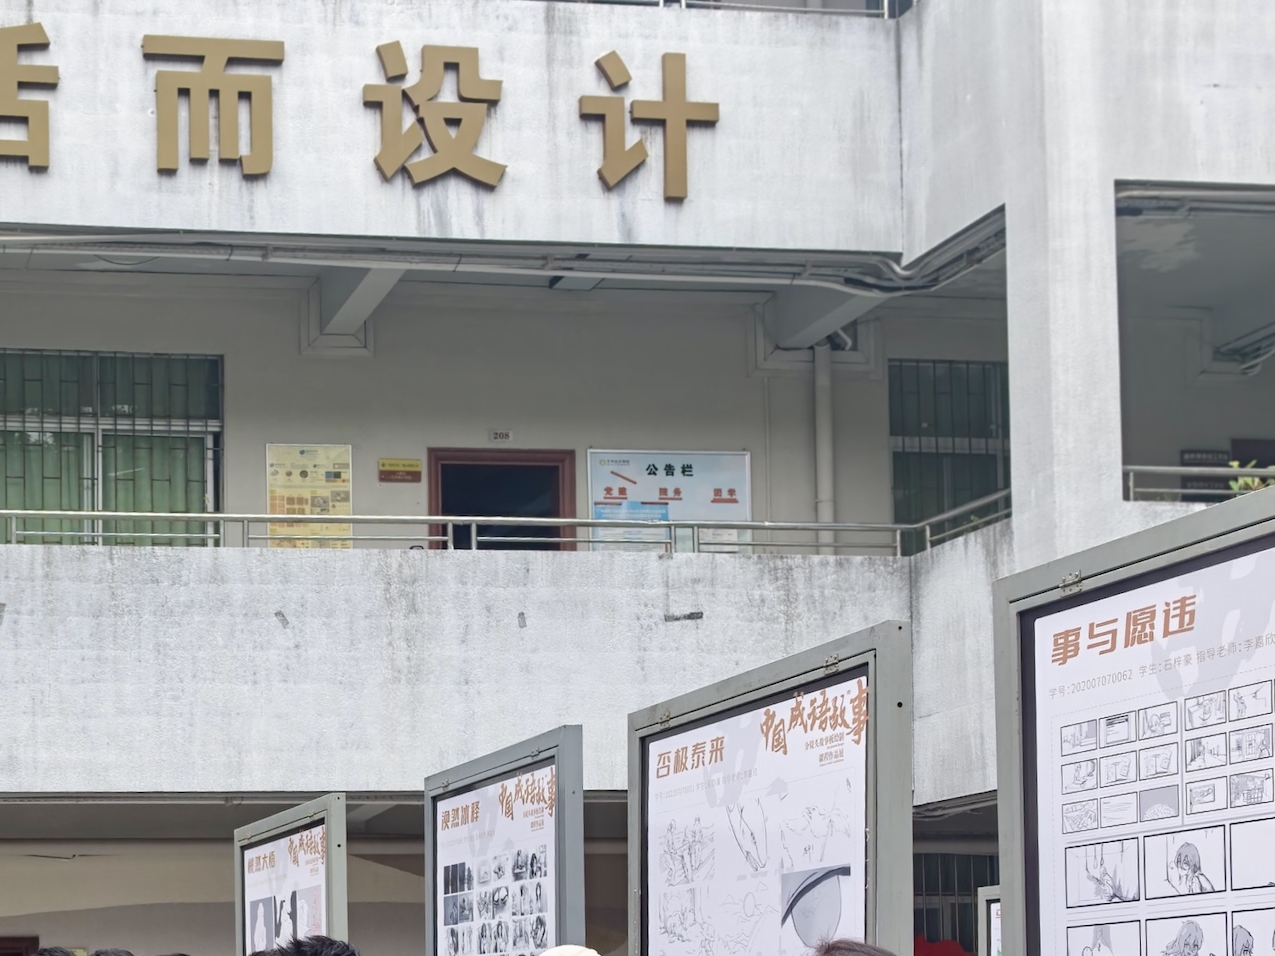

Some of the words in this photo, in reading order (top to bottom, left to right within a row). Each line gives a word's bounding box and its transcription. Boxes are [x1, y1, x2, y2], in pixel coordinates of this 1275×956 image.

[492, 431, 510, 441] 208
[645, 463, 694, 477] 公告栏
[1051, 594, 1197, 666] 事与愿违
[760, 678, 869, 756] 中国成语故事
[655, 735, 725, 779] 否极泰来
[441, 800, 480, 831] 涣然冰释
[498, 767, 556, 821] 中国成语故事
